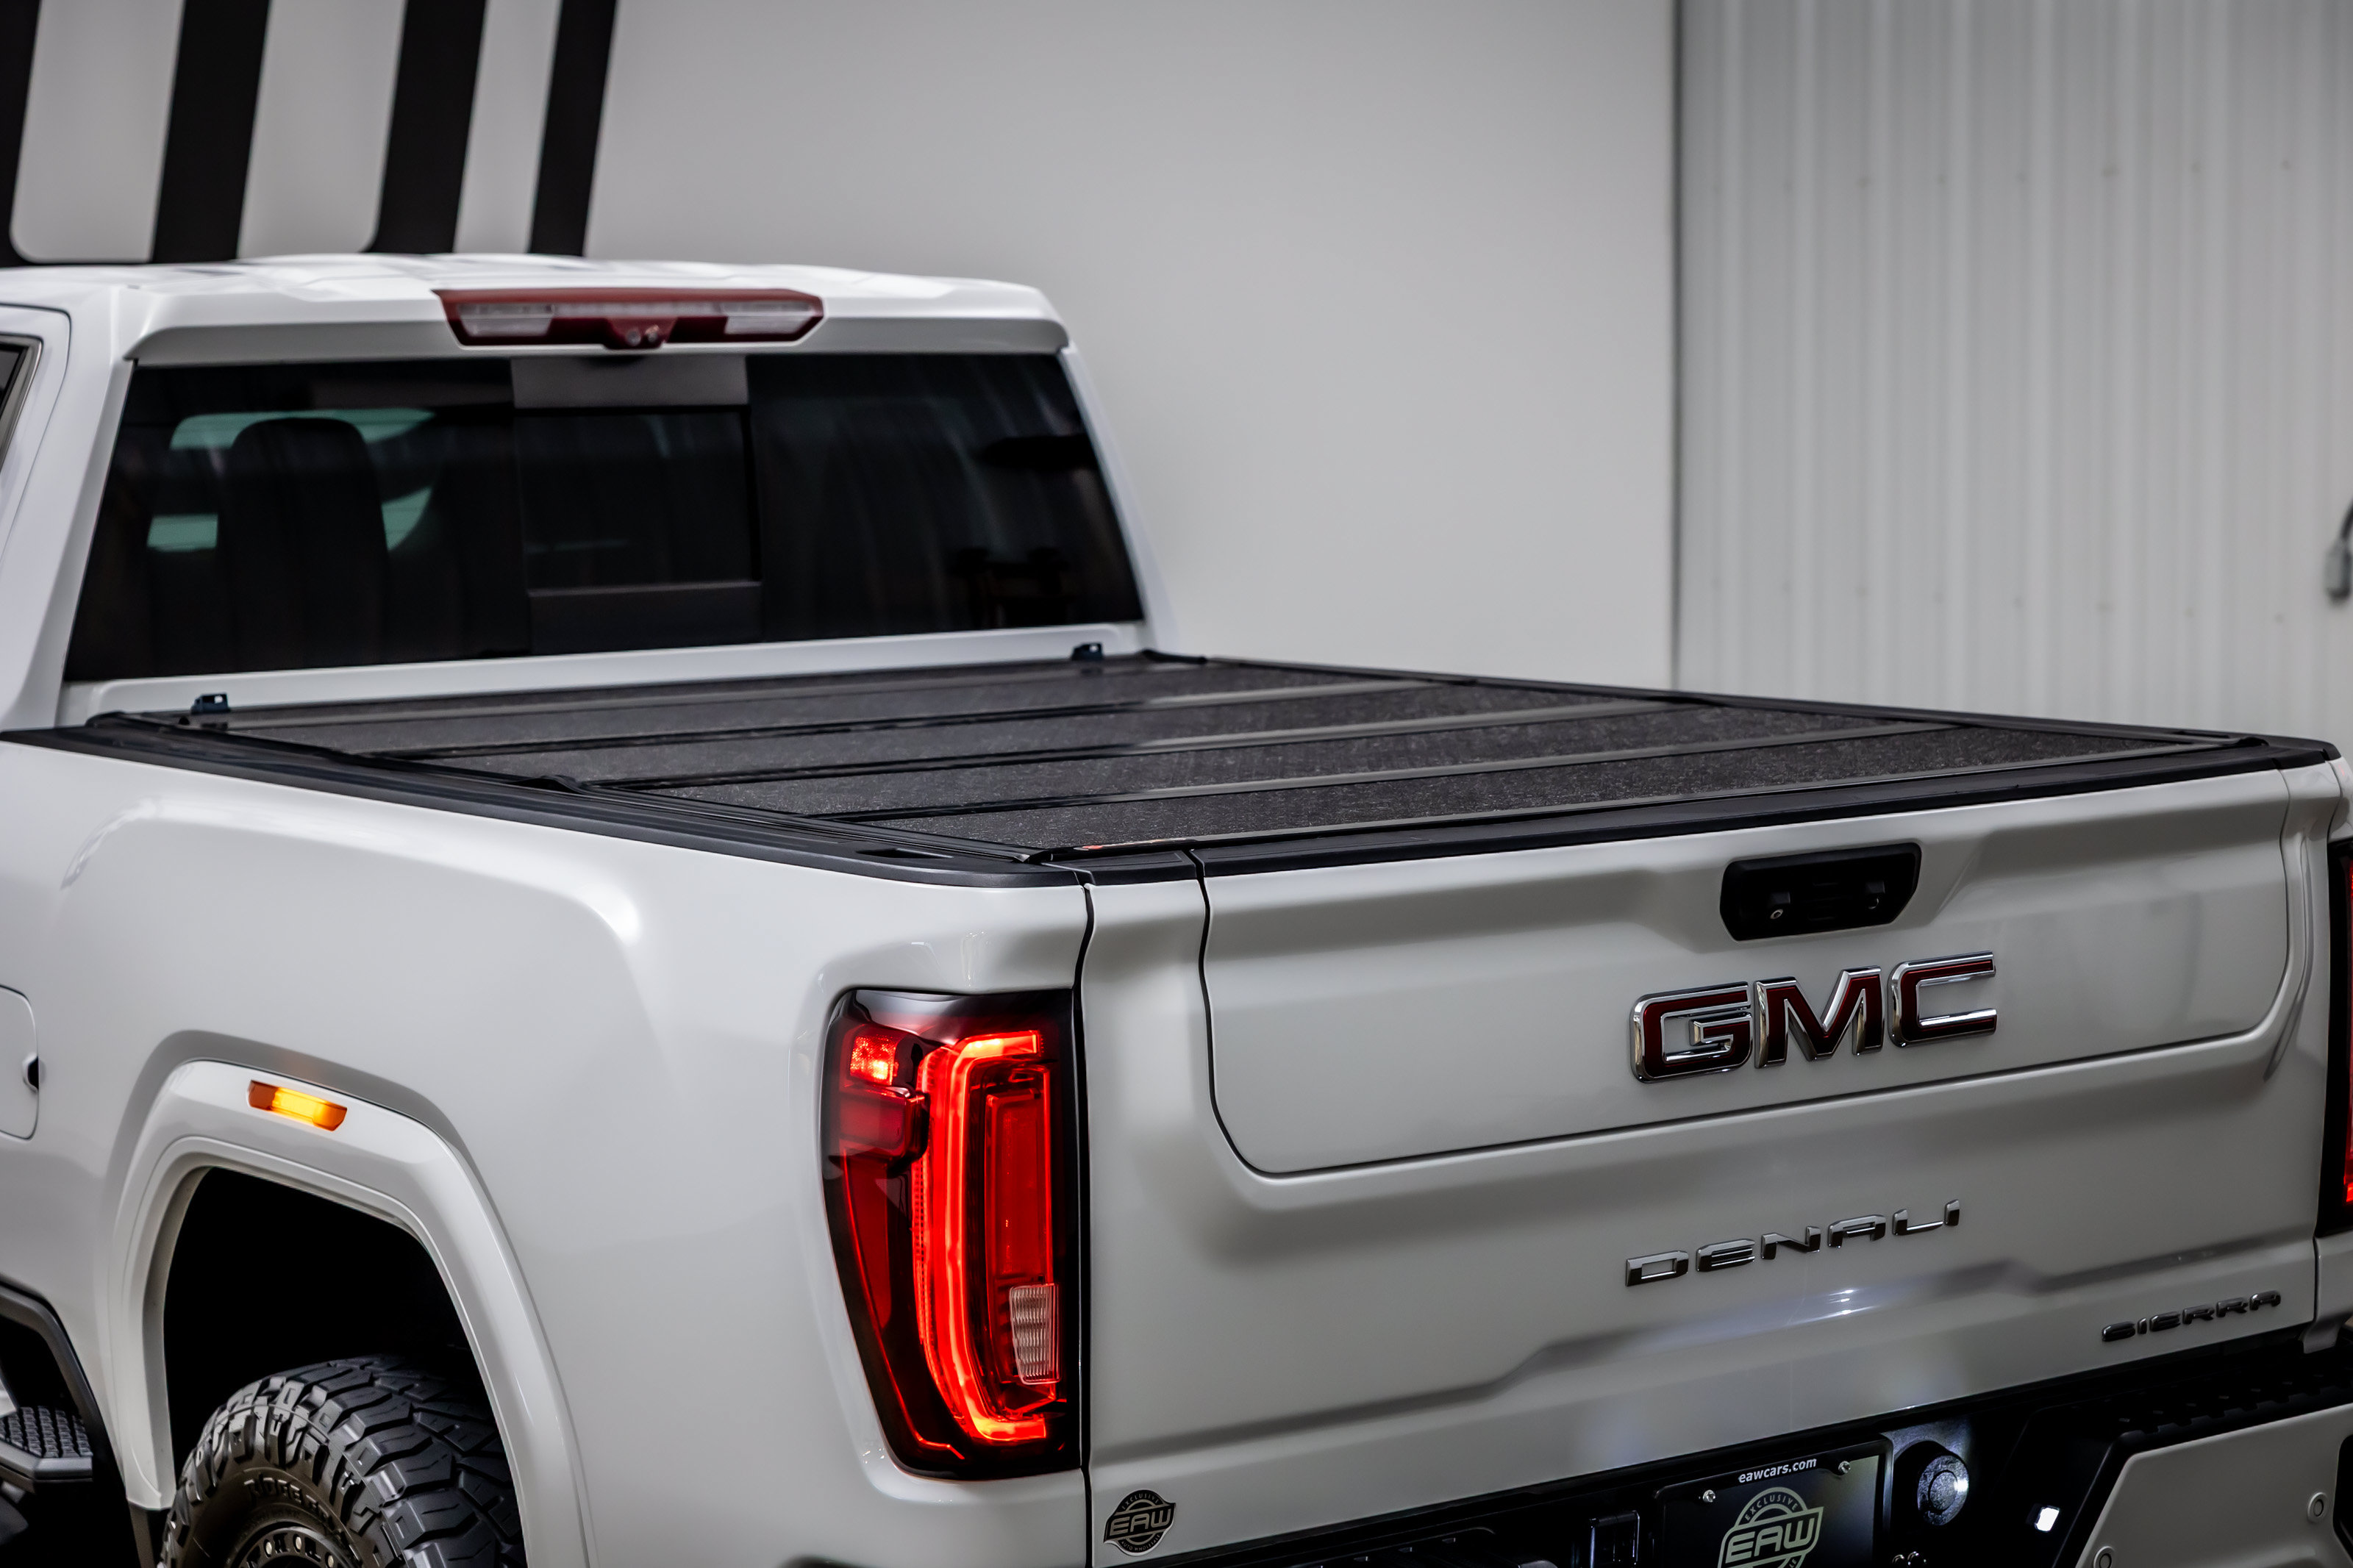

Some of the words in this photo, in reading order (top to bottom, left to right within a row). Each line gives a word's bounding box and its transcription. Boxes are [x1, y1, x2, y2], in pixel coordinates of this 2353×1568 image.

[1630, 951, 1996, 1084] GMC
[1625, 1199, 1960, 1286] DENALI
[2102, 1290, 2282, 1342] SIERRA
[1738, 1458, 1817, 1483] eawcars.com
[1121, 1492, 1160, 1510] EXCLUSIVE
[1744, 1494, 1799, 1521] EXCLUSIVE
[1109, 1508, 1171, 1536] EAW
[1121, 1540, 1133, 1551] AUTO
[1725, 1517, 1815, 1564] EAW
